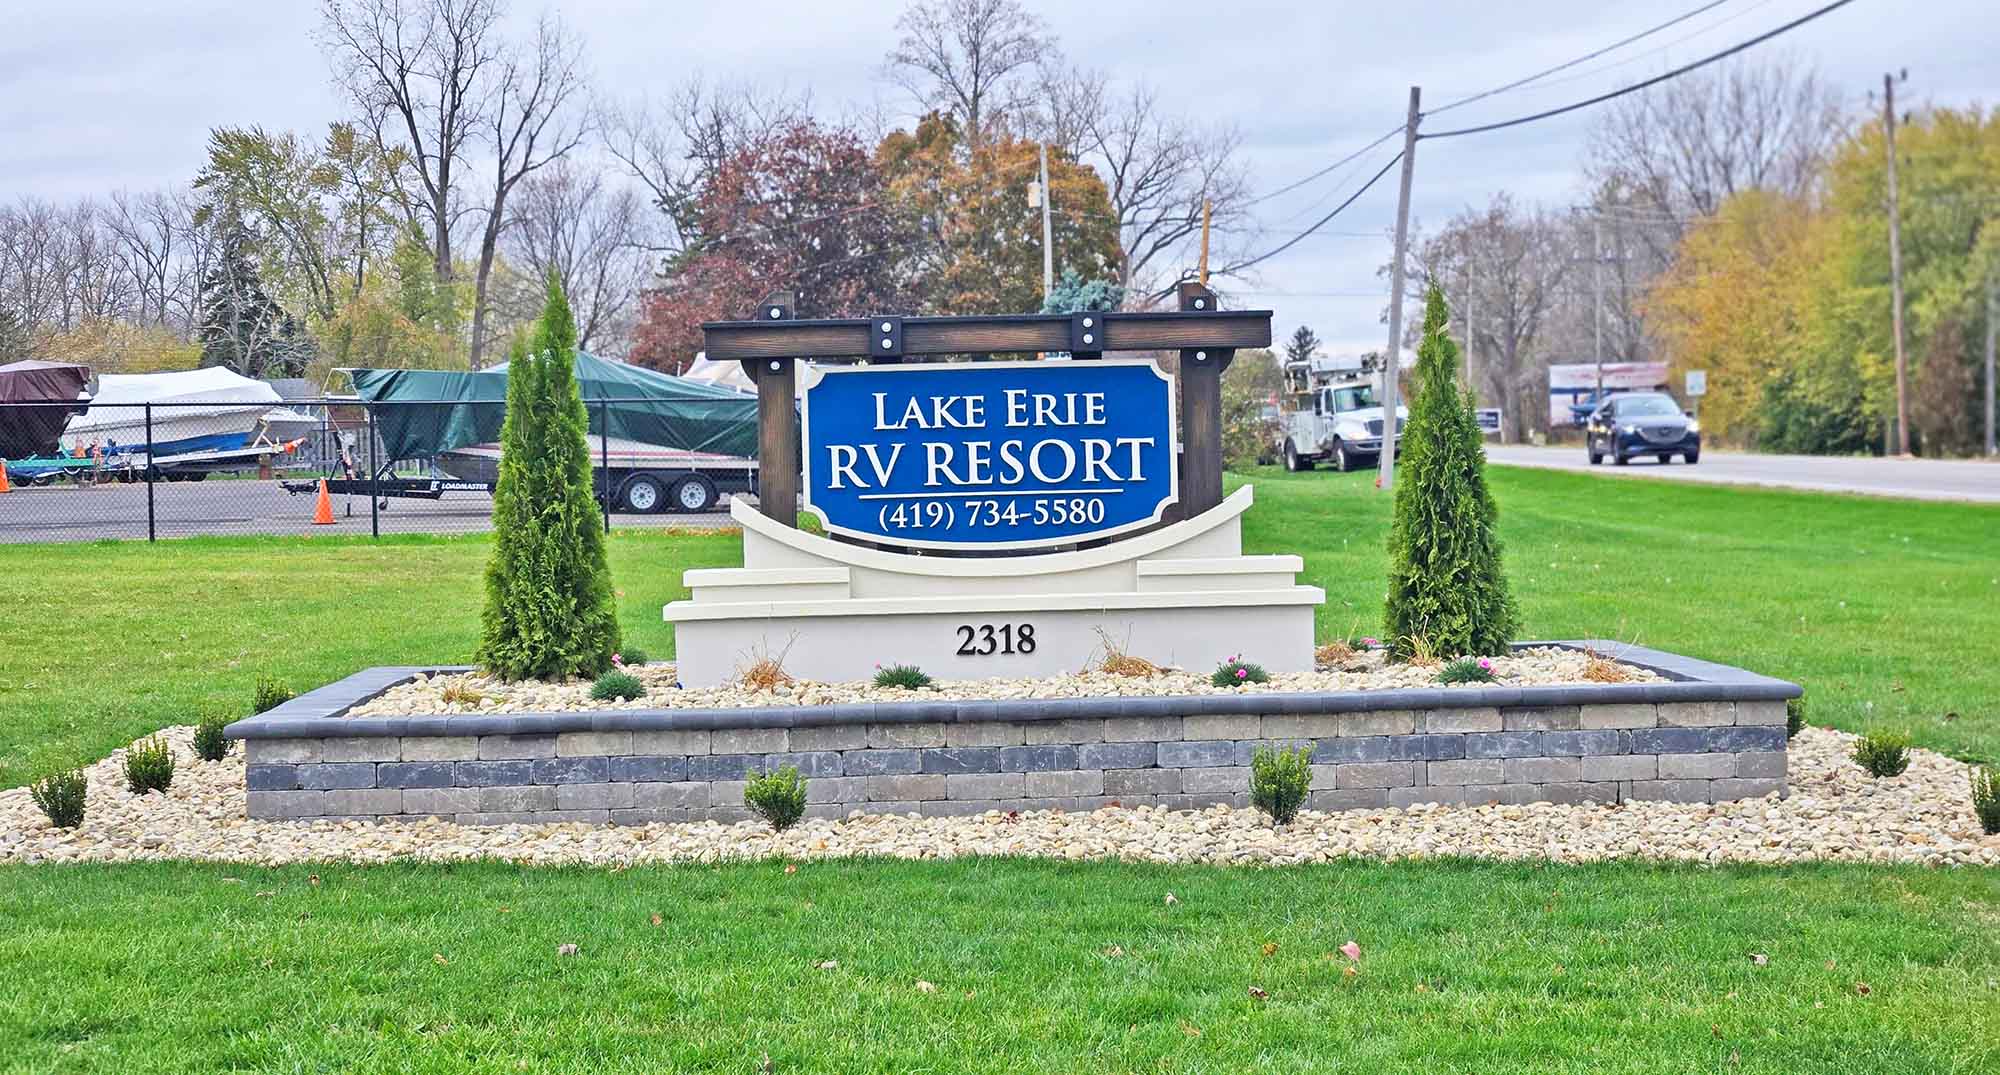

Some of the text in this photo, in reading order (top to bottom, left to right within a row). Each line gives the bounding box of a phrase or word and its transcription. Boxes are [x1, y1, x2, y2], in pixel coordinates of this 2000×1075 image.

[871, 389, 1106, 430] LAKE ERIE
[826, 436, 1155, 489] RV RESORT
[878, 498, 1105, 532] (419) 734-5580
[956, 623, 1036, 656] 2318
